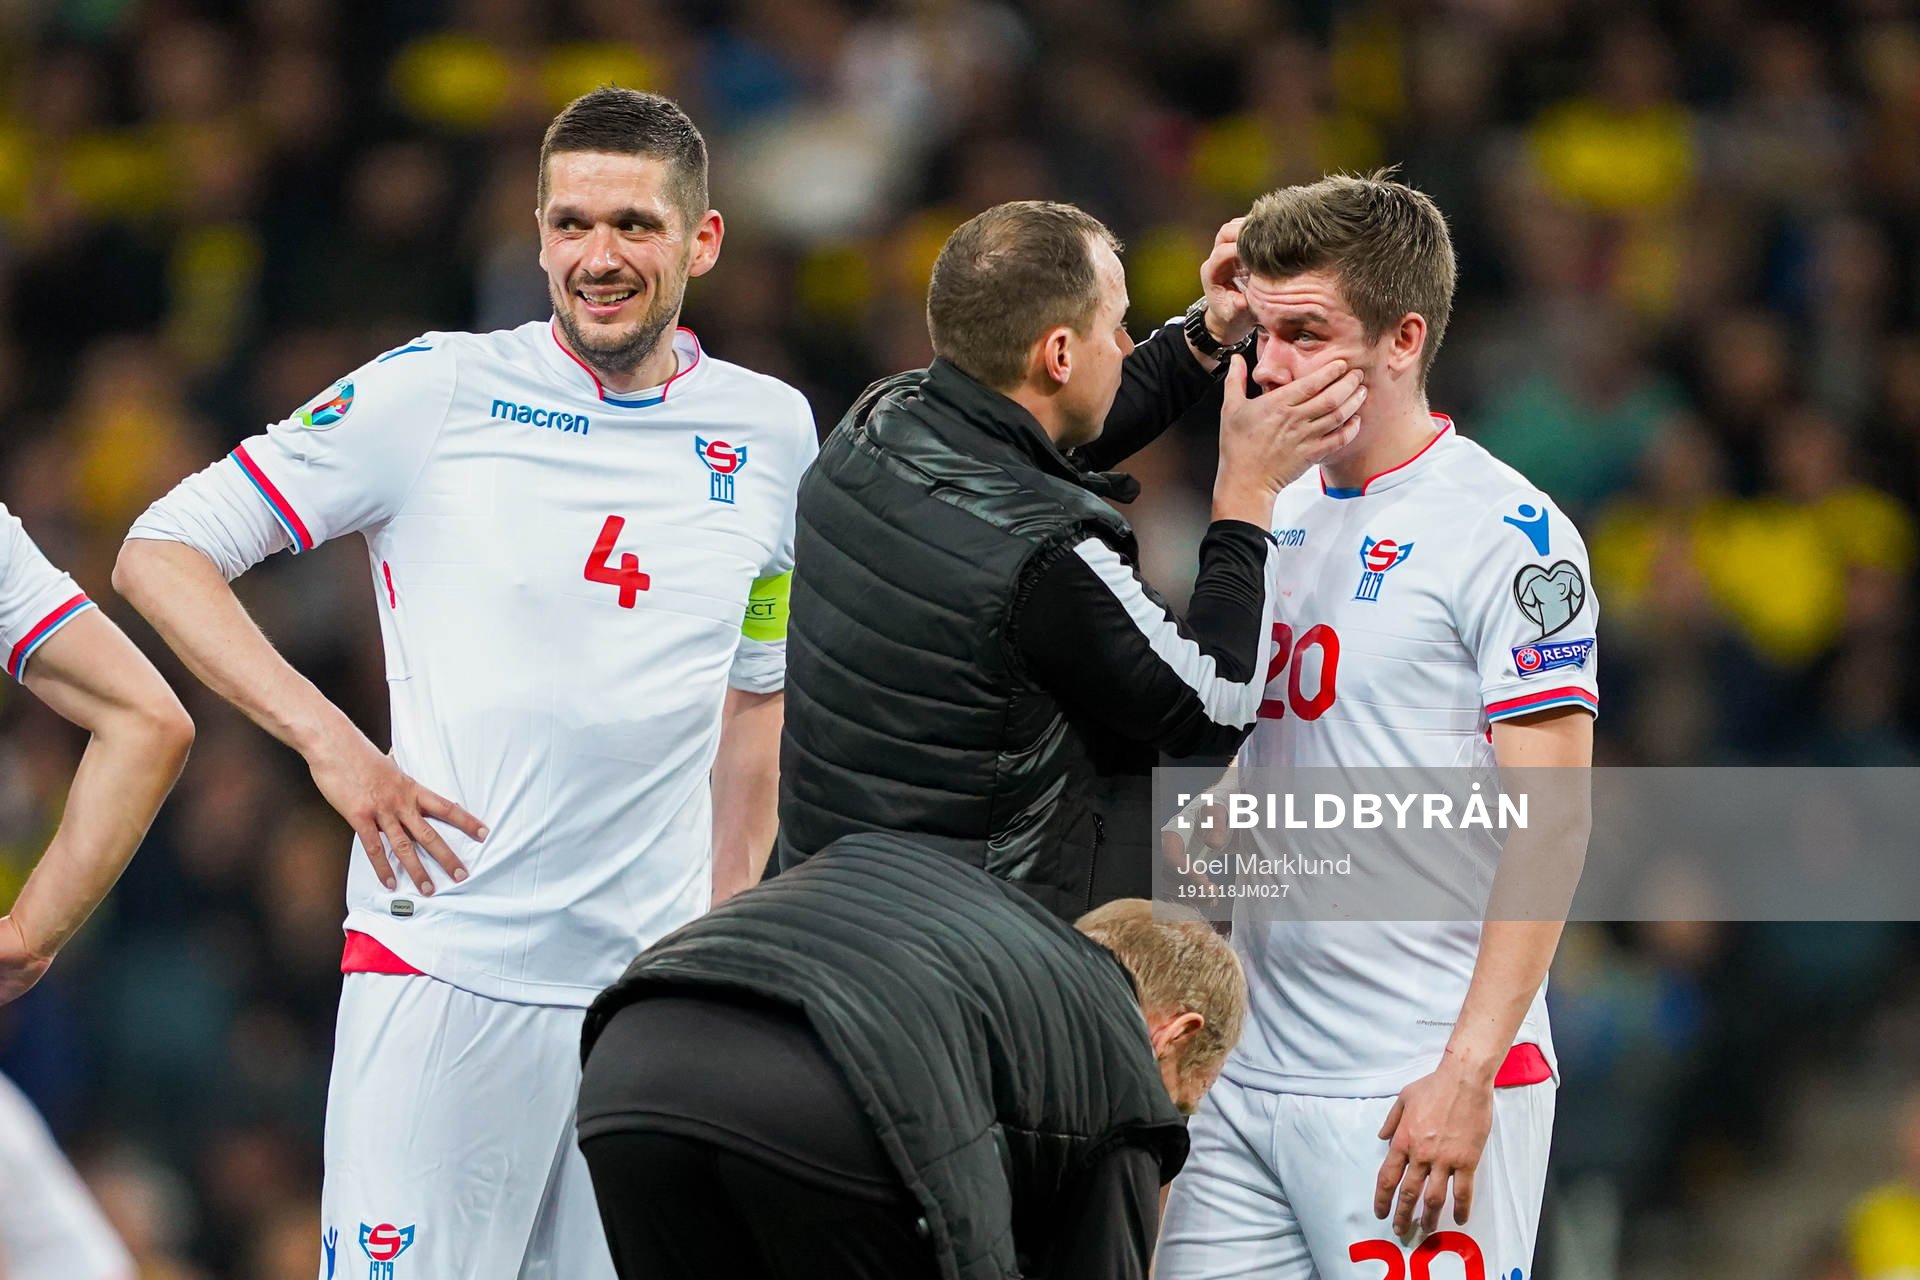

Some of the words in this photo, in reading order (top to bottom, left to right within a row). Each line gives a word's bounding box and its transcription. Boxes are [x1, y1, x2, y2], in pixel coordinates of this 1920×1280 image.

[490, 399, 590, 435] macron
[584, 515, 650, 609] 4
[1256, 622, 1340, 722] 20
[1542, 645, 1592, 662] RESPE
